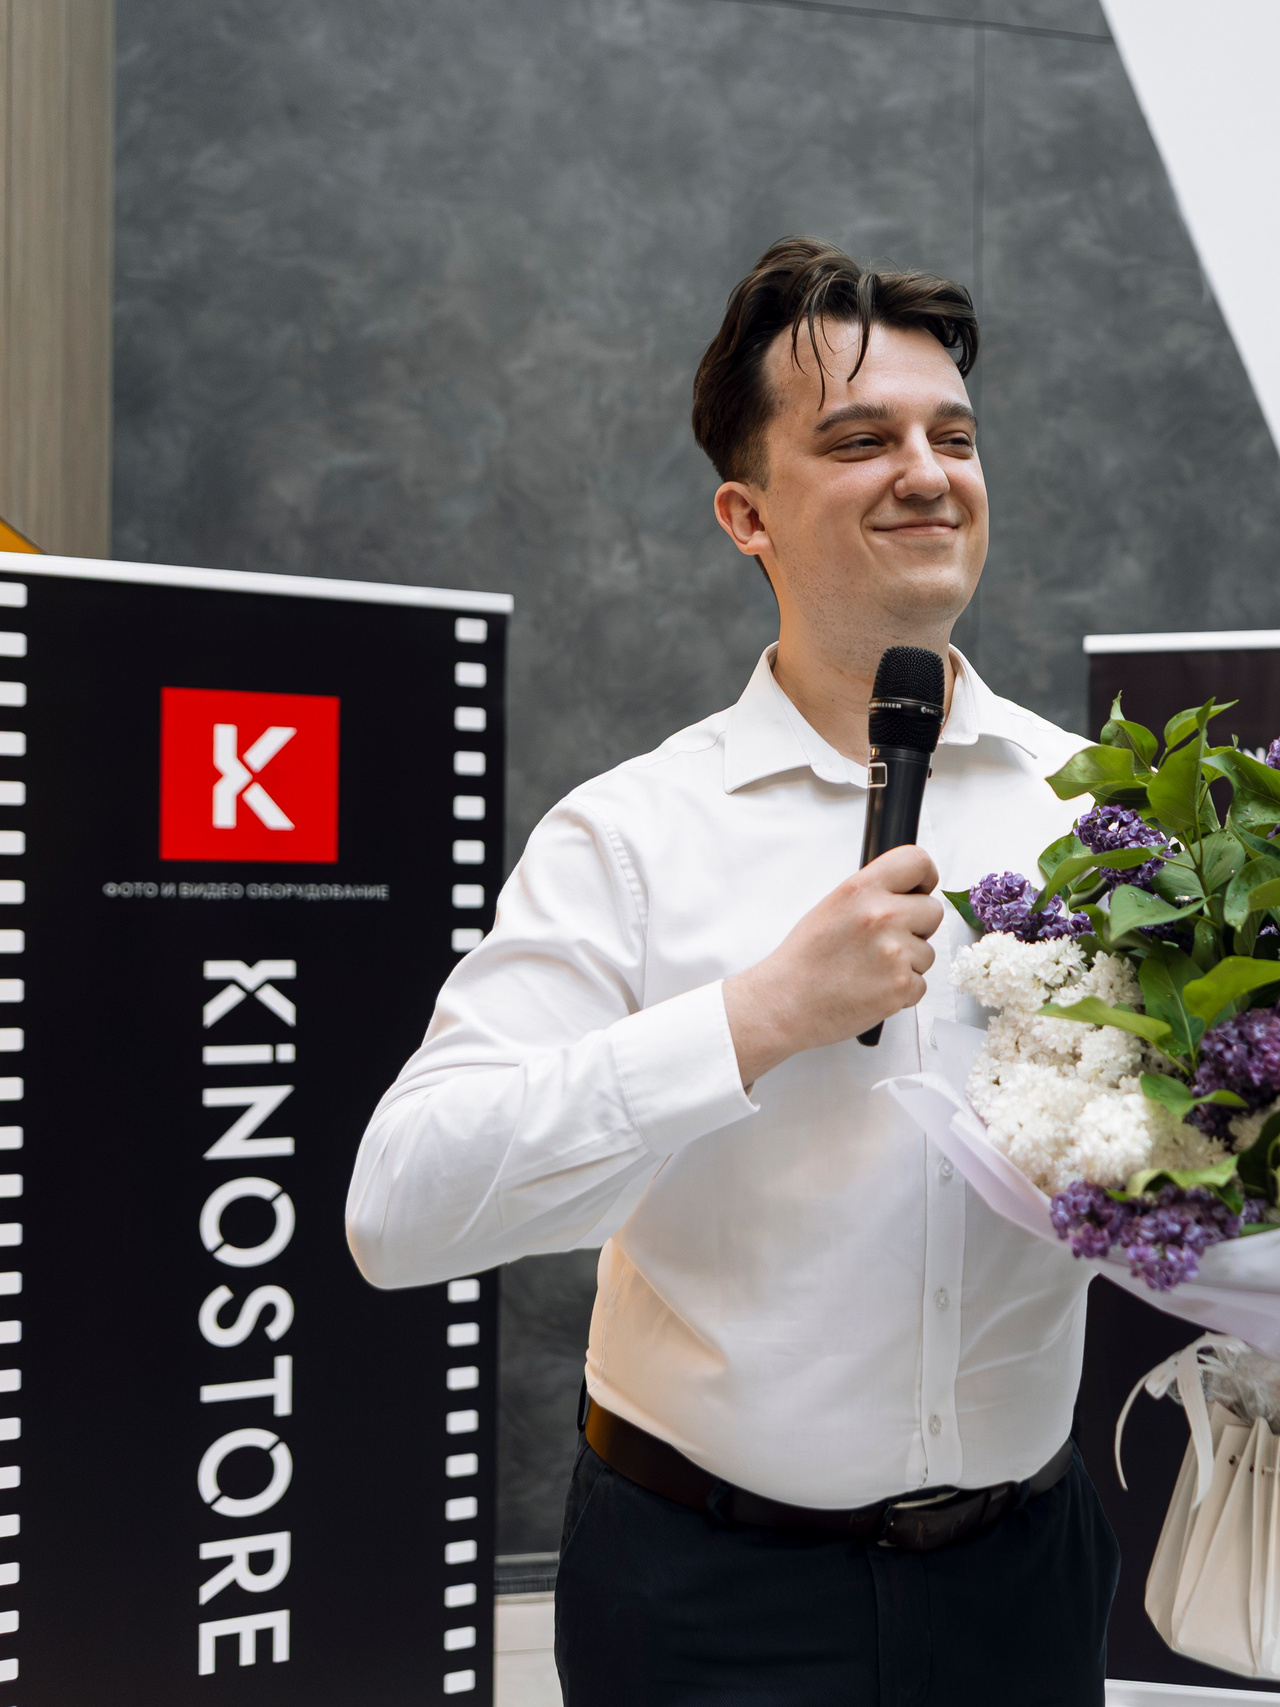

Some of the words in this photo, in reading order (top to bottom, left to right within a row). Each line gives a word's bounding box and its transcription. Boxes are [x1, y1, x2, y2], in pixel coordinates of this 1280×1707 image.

[212, 723, 297, 831] K
[102, 882, 159, 899] ФОТО
[160, 882, 177, 899] И
[178, 882, 244, 900] ВИДЕО
[246, 883, 389, 901] ОБОРУДОВАНИЕ
